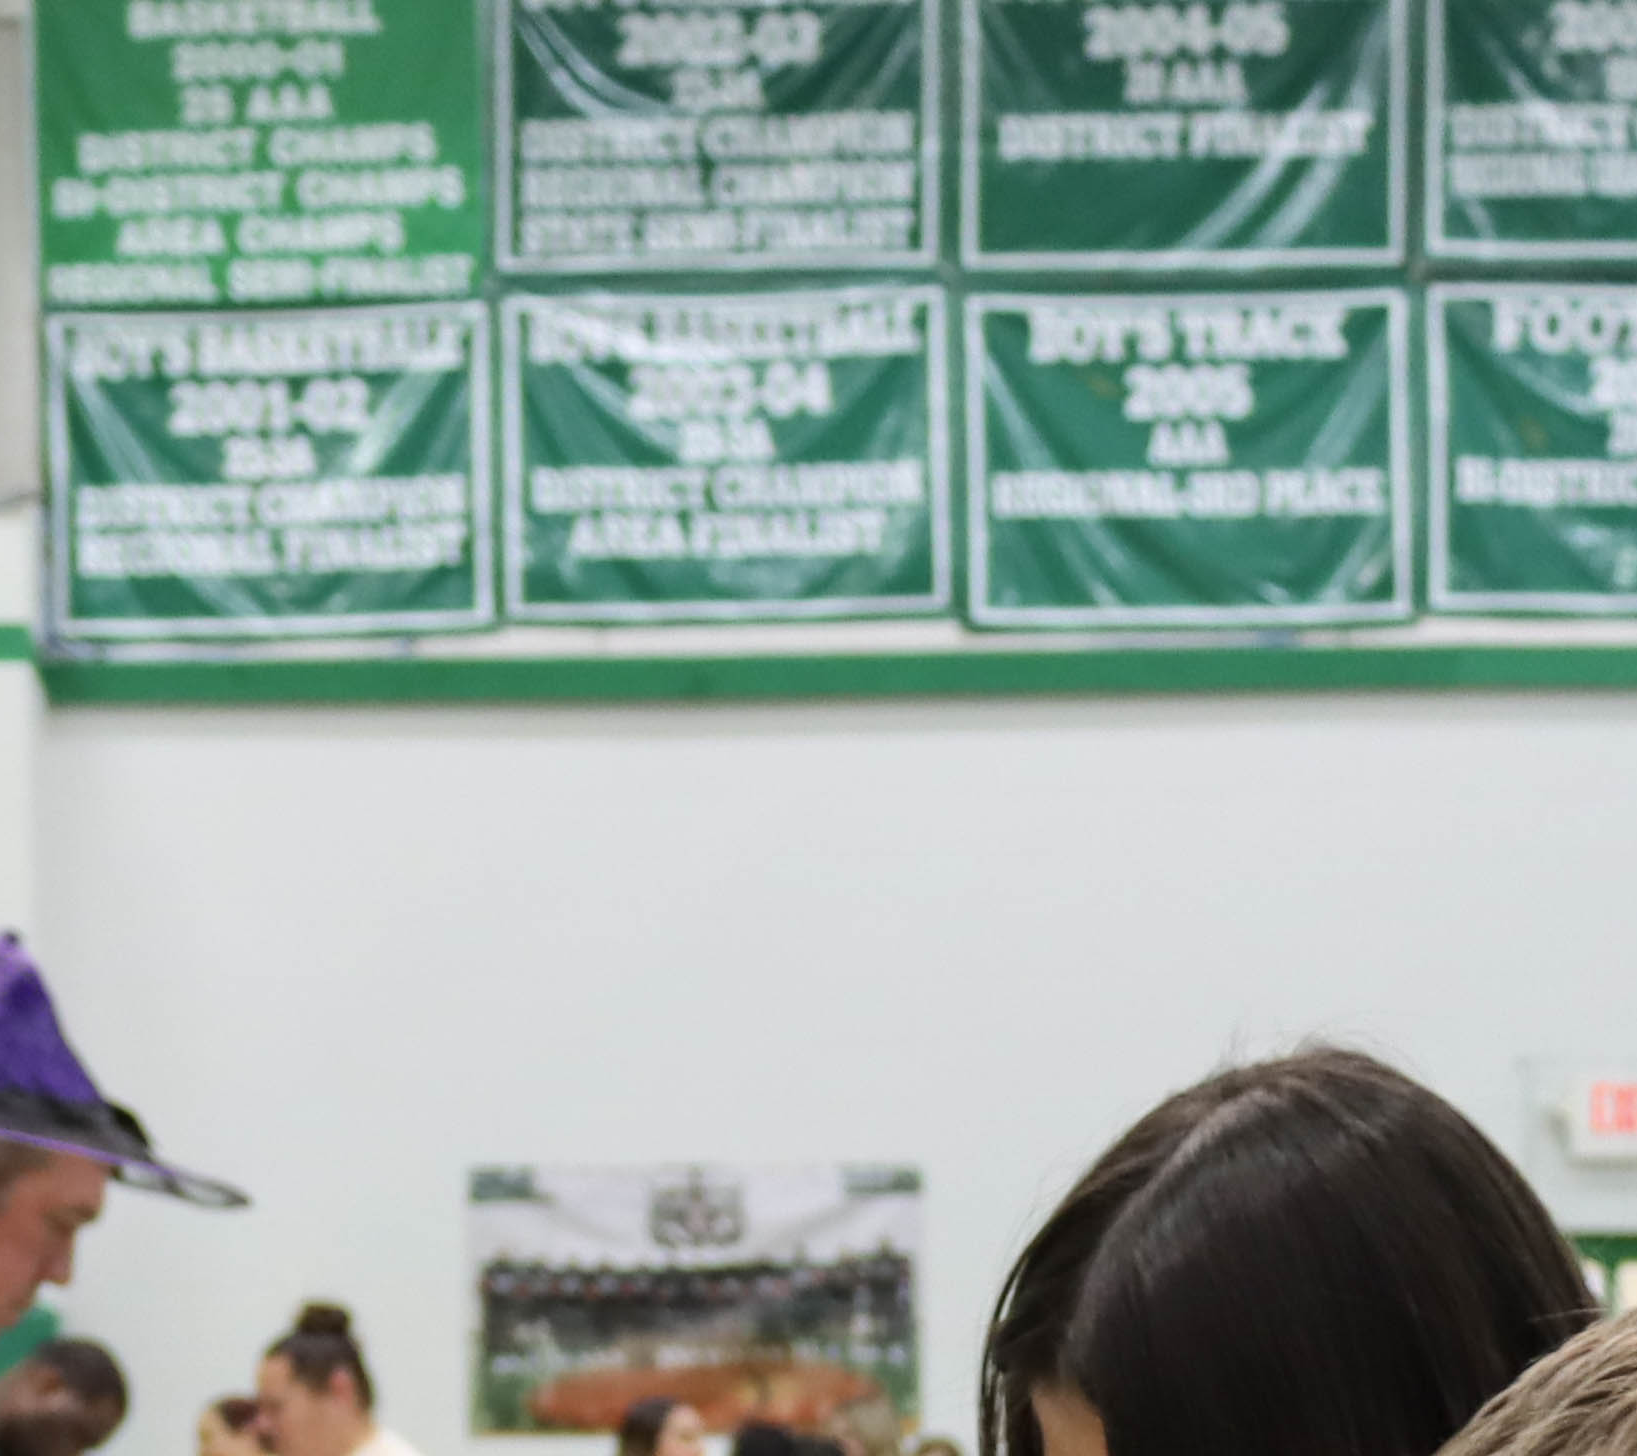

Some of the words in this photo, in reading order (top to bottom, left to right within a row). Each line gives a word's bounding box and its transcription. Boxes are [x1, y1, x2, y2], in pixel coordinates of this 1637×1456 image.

[77, 130, 256, 172] DISTRICT
[270, 122, 436, 166] CHAMPS
[525, 117, 694, 161] DISTRICT
[702, 111, 915, 158] CHAMPION
[1000, 115, 1182, 161] DISTRICT
[1188, 111, 1373, 158] FINALIST
[1450, 103, 1632, 149] DISTRICT
[51, 172, 286, 218] BI-DISTRICT
[296, 167, 464, 208] CHAMPS
[524, 165, 702, 208] REGIONAL
[711, 160, 915, 204] CHAMPION
[115, 216, 227, 256] AREA
[236, 212, 405, 254] CHAMPS
[47, 261, 218, 303] REGIONAL
[198, 320, 466, 373] BASKETBALL
[657, 303, 919, 357] BASKETBALL
[1183, 304, 1349, 358] TRACK
[1148, 423, 1229, 468] AAA
[78, 484, 250, 527] DISTRICT
[257, 476, 467, 523] CHAMPION
[533, 465, 708, 513] DISTRICT
[715, 461, 922, 510] CHAMPION
[1265, 469, 1386, 515] PLACE
[78, 527, 276, 575] REGIONAL
[284, 523, 467, 571] FINALIST
[571, 514, 684, 558] AREA
[690, 510, 884, 556] FINALIST
